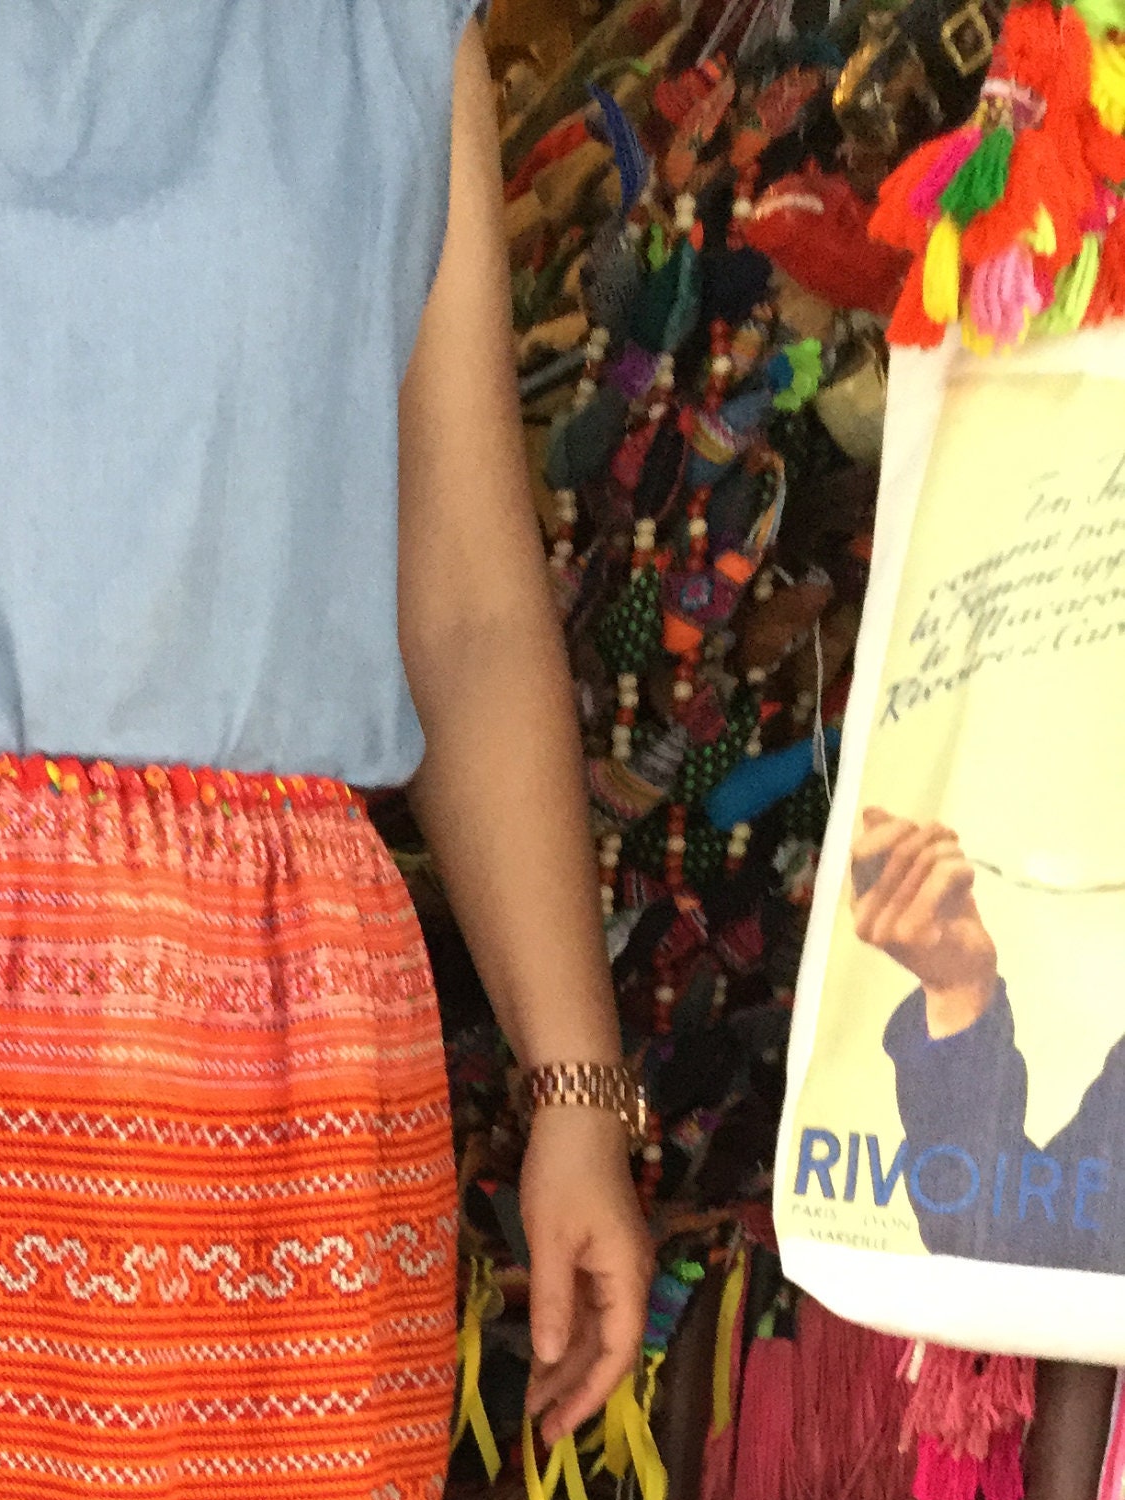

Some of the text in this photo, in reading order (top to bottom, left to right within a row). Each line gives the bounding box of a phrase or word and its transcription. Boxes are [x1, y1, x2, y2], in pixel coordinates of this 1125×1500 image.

[793, 1126, 1109, 1230] RIVOIRE
[792, 1203, 911, 1231] PARIS LYON
[809, 1228, 888, 1250] MARSEILLE
